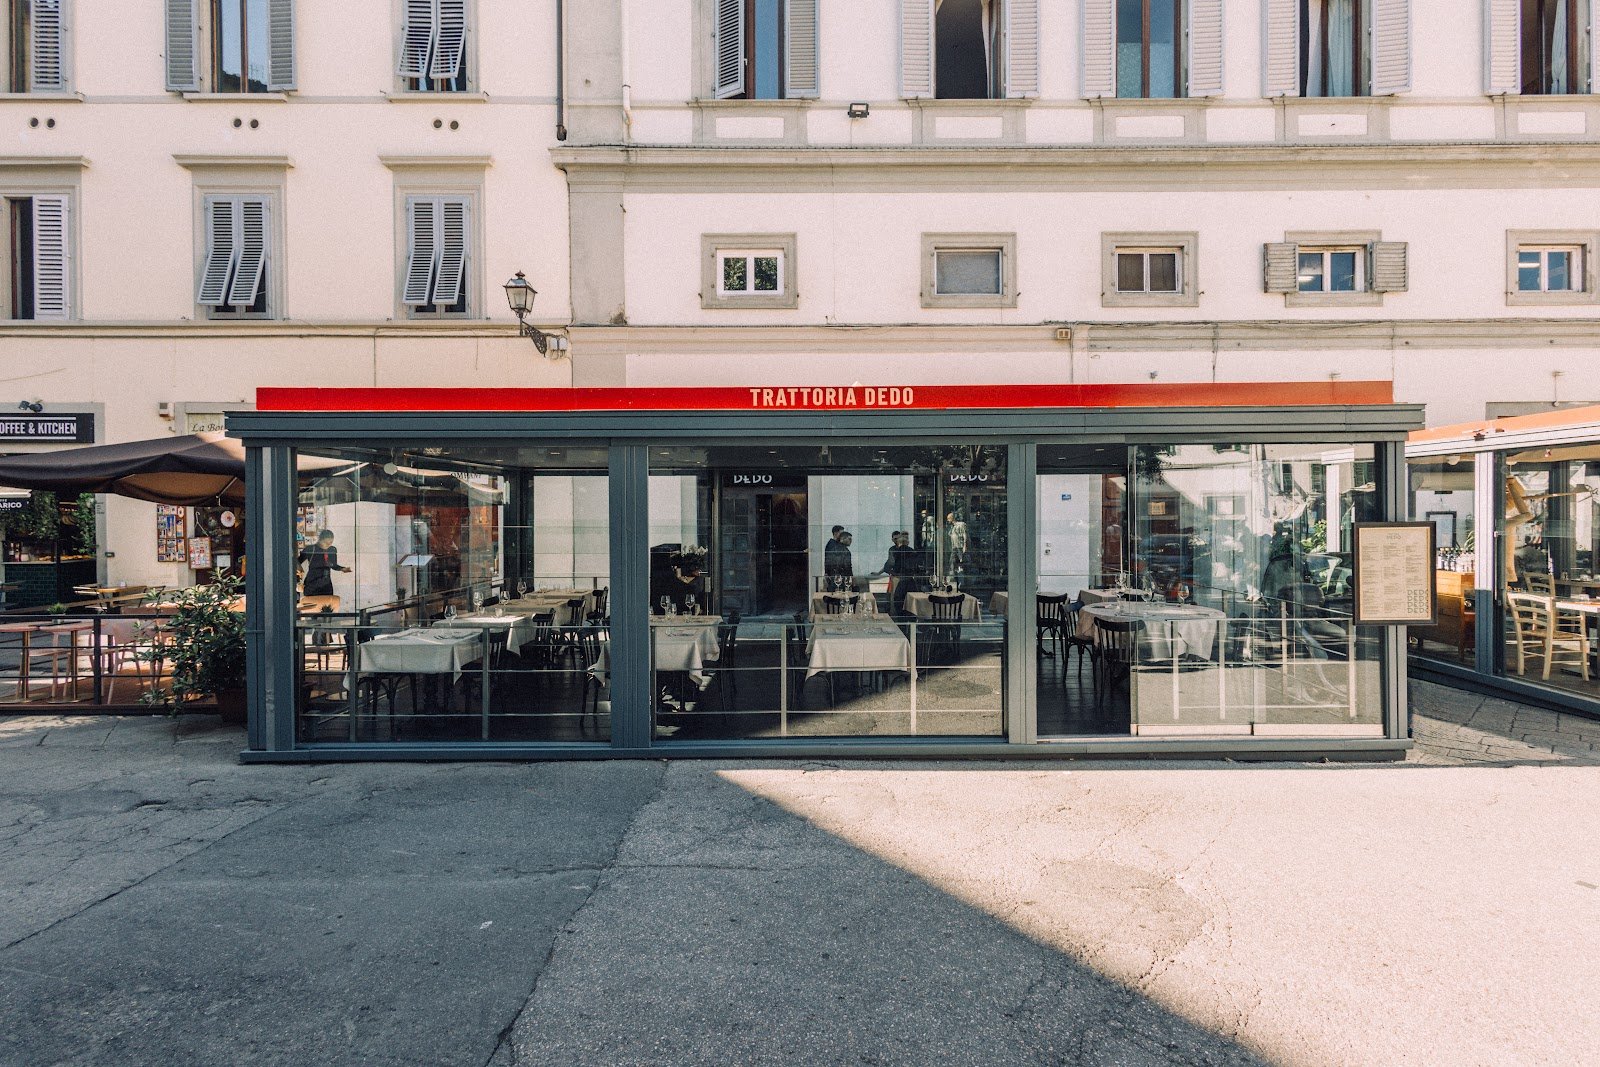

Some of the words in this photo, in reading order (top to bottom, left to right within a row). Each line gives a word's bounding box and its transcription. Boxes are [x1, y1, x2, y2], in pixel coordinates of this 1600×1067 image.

[750, 388, 857, 407] TRATTORIA
[864, 387, 914, 406] DEDO
[28, 422, 35, 434] &
[38, 422, 77, 434] KITCHEN
